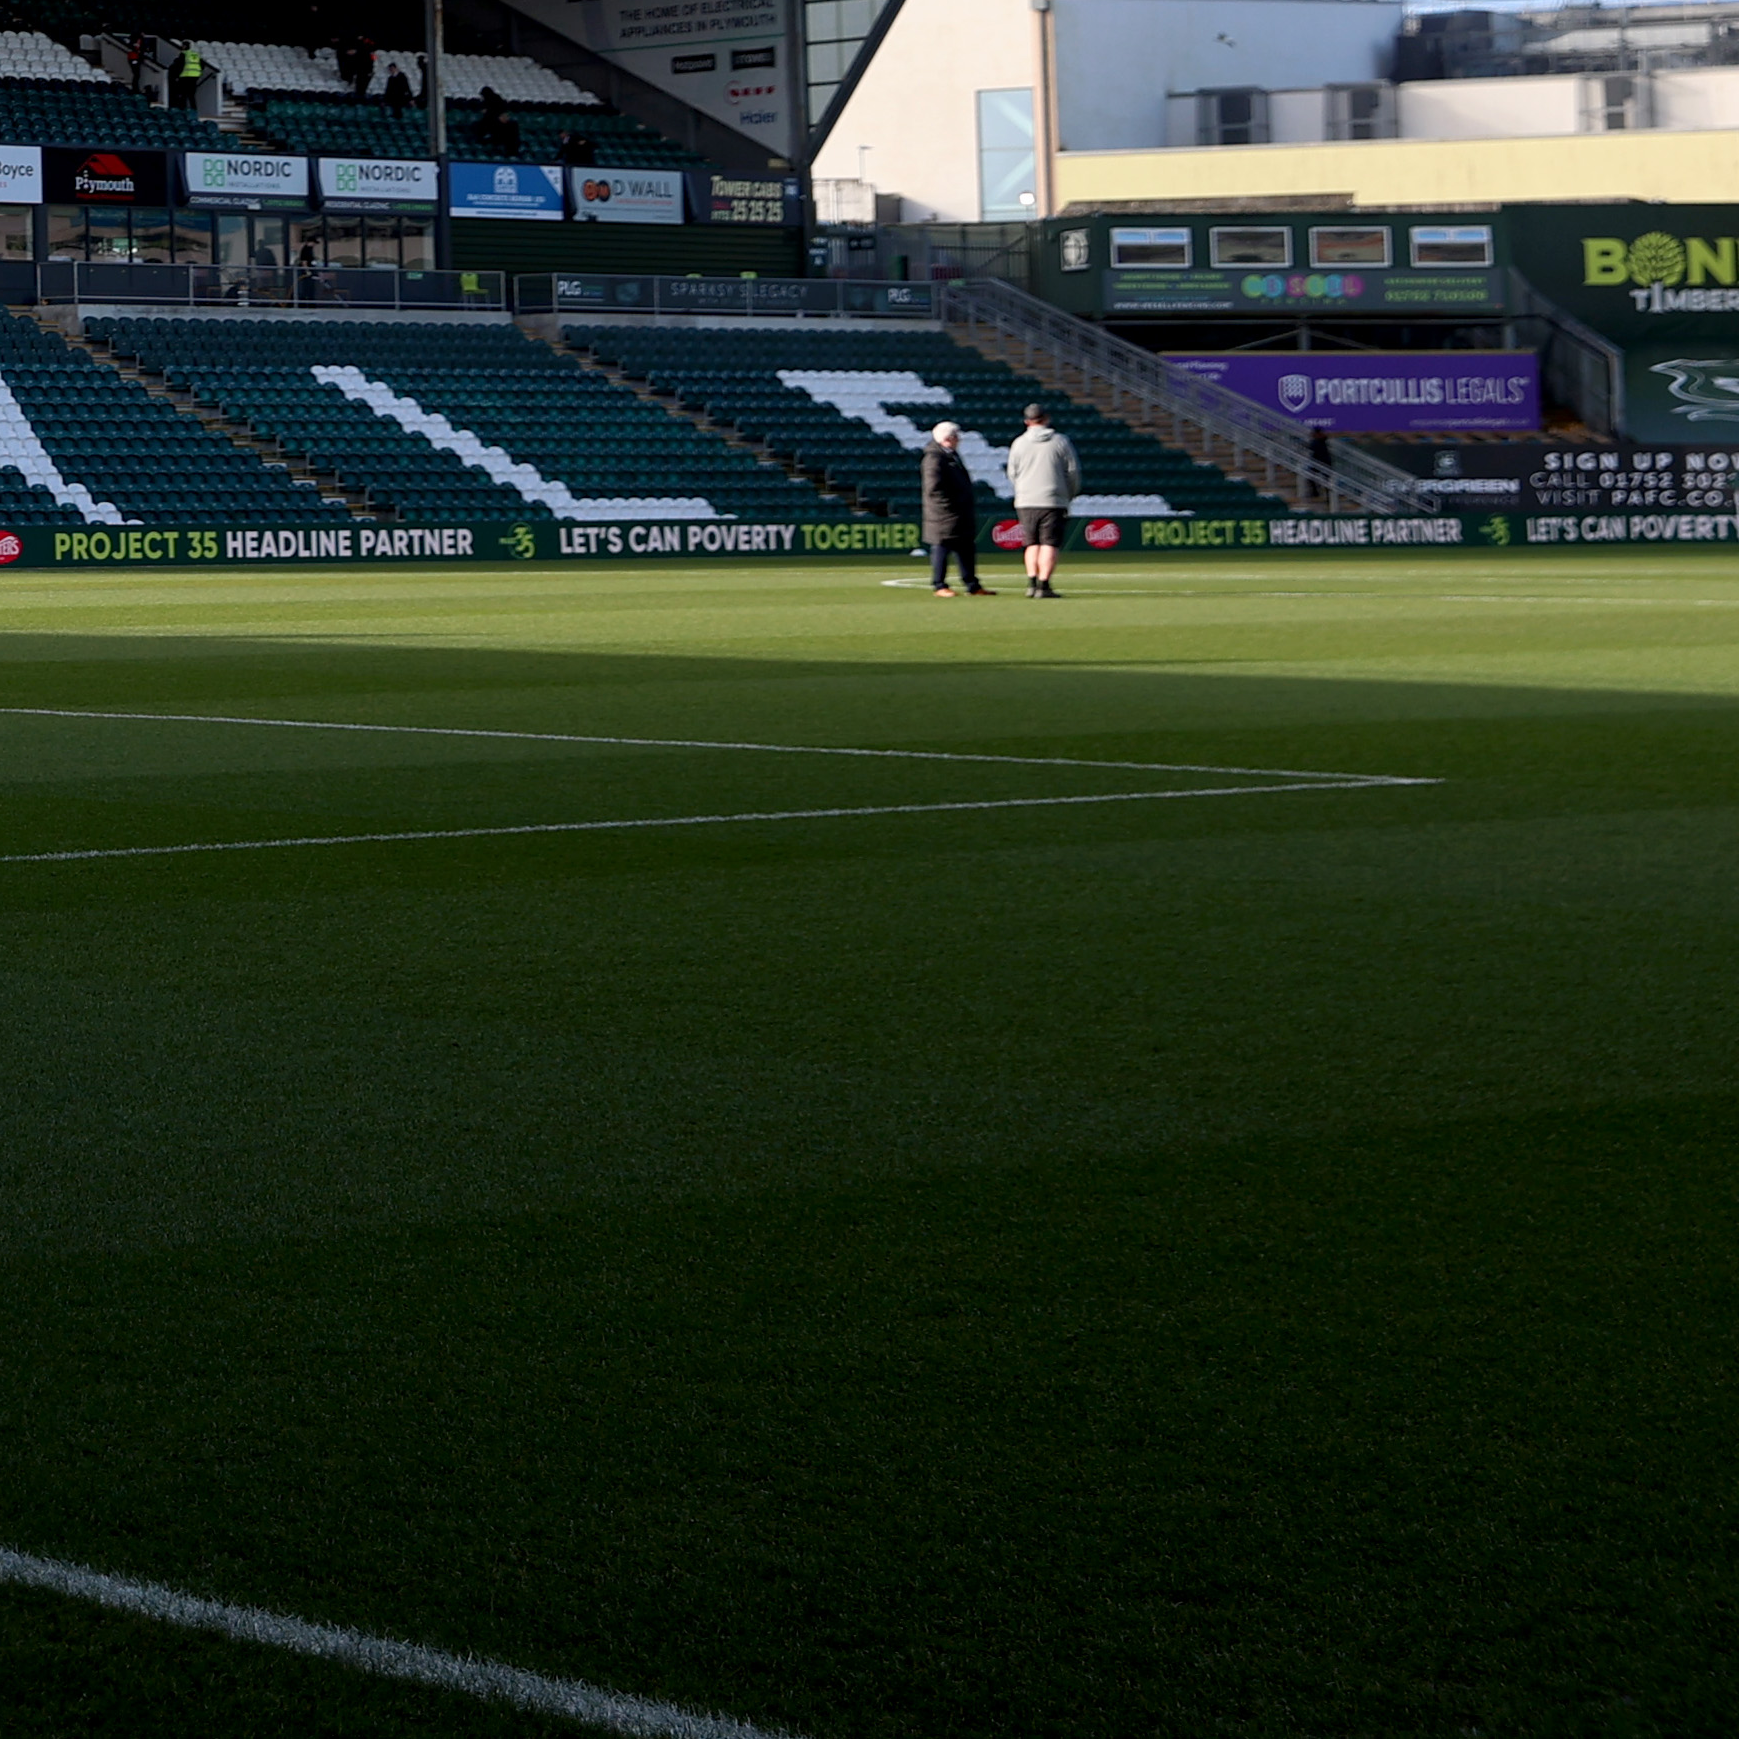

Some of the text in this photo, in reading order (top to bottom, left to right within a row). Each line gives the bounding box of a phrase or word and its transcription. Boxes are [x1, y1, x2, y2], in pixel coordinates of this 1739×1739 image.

[619, 9, 640, 22] THE
[644, 6, 678, 20] HOME
[226, 160, 292, 178] NORDIC
[628, 180, 673, 197] WALL
[1314, 376, 1527, 405] PORTCULLIS LEGALS
[1543, 451, 1674, 472] SIGN UP
[1529, 472, 1590, 489] CALL
[1598, 472, 1674, 490] 01752
[1537, 489, 1601, 507] VISIT
[559, 526, 624, 555] LET'S
[628, 525, 681, 553] CAN
[687, 524, 797, 552] POVERTY
[800, 522, 921, 551] TOGETHER
[1141, 520, 1237, 546] PROJECT
[1240, 520, 1267, 545] 35
[1269, 519, 1370, 545] HEADLINE
[1371, 518, 1464, 544] PARTNER
[1526, 516, 1627, 542] LET'S CAN
[54, 530, 180, 561] PROJECT
[187, 530, 219, 559] 35
[226, 529, 353, 559] HEADLINE
[360, 528, 474, 556] PARTNER
